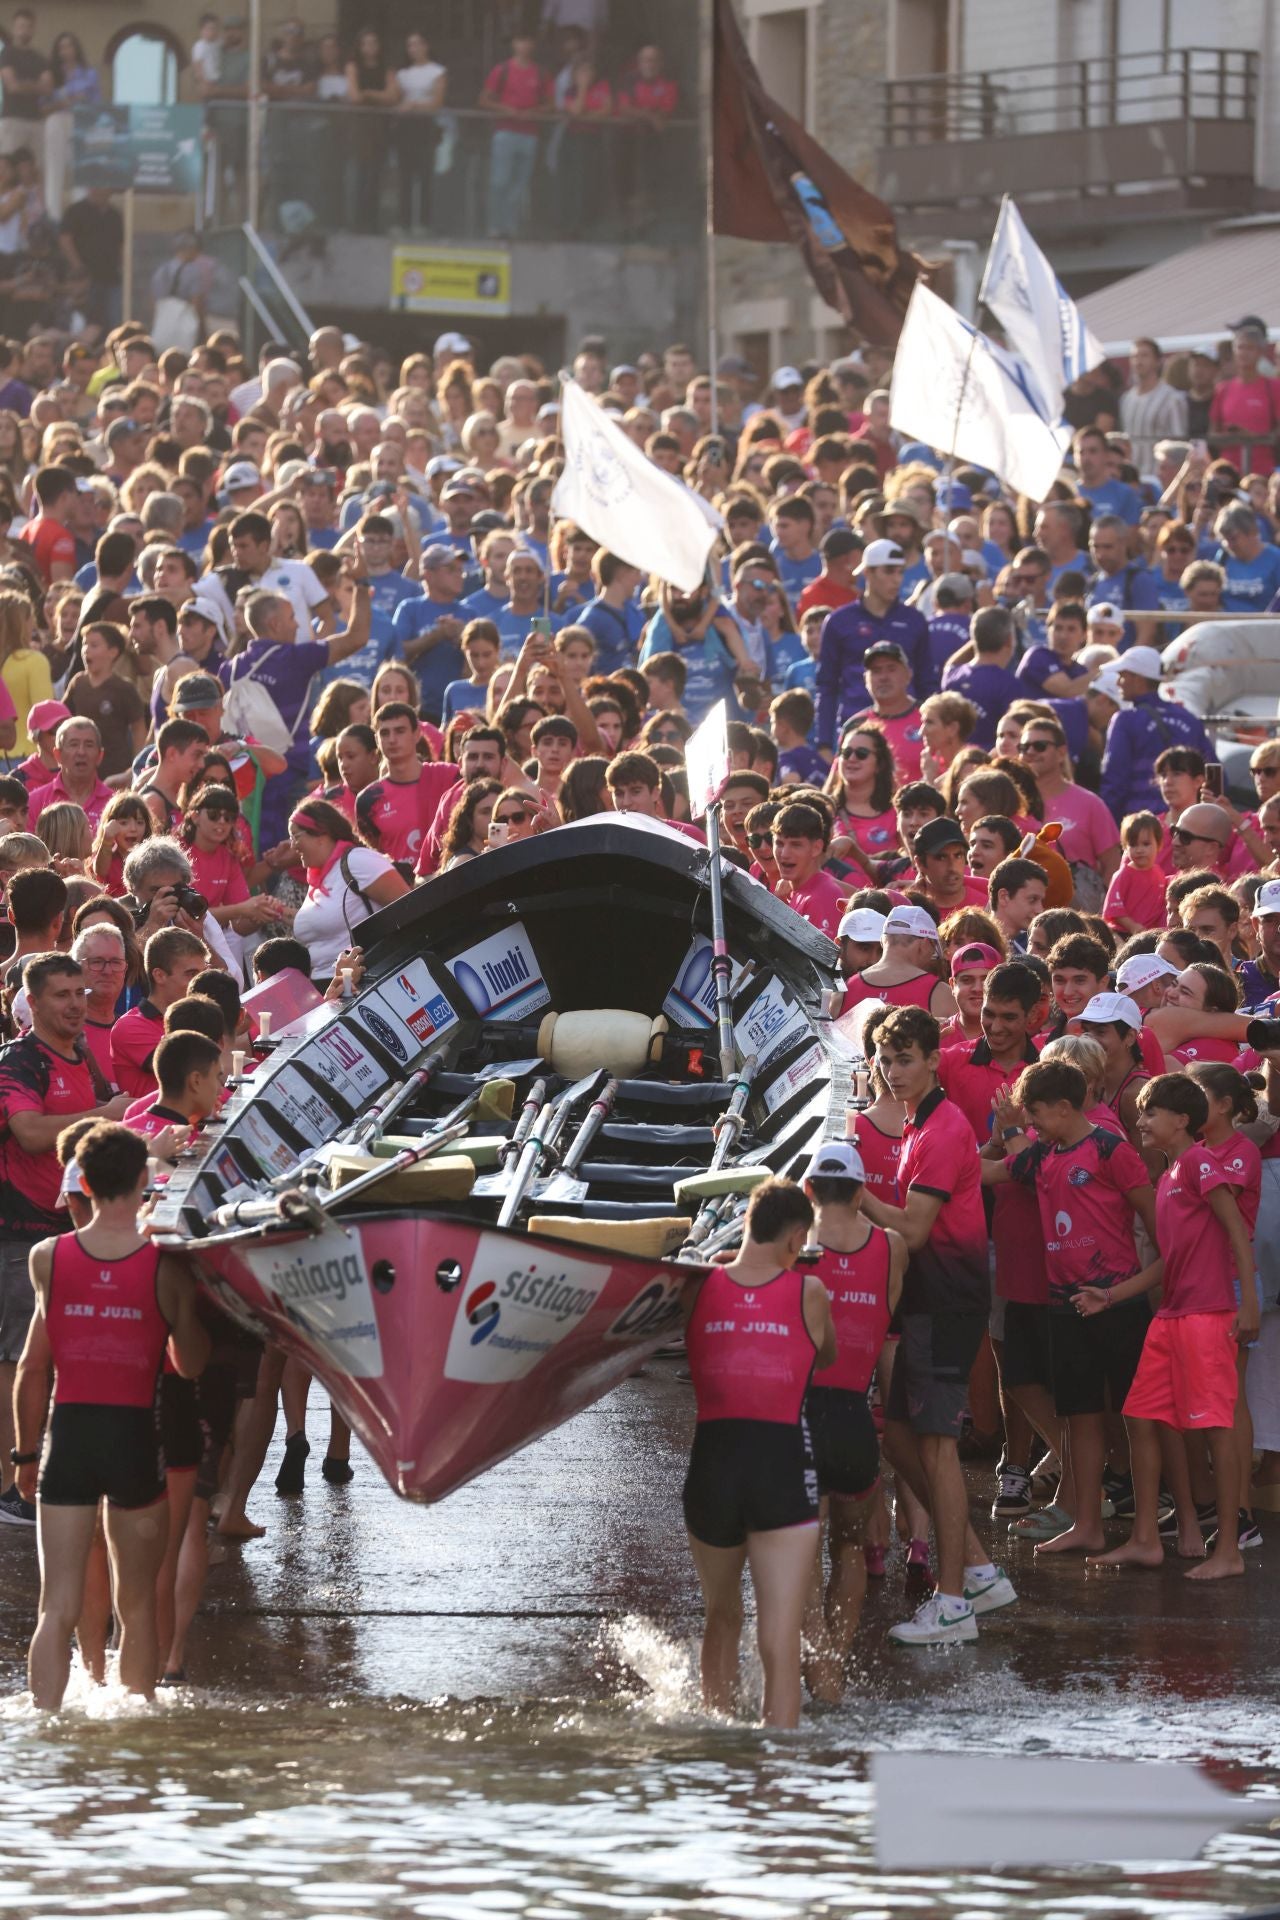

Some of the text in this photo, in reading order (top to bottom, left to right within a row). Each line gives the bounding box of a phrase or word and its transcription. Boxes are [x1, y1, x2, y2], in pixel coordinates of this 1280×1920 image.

[481, 945, 531, 996] ilunki
[411, 1013, 431, 1036] EROSKI
[759, 1003, 788, 1034] AGM
[270, 1253, 364, 1301] sistiaga
[500, 1264, 599, 1323] sistiaga
[840, 1291, 877, 1306] JUAN
[64, 1303, 143, 1321] SAN JUAN
[704, 1320, 790, 1337] SAN JUAN
